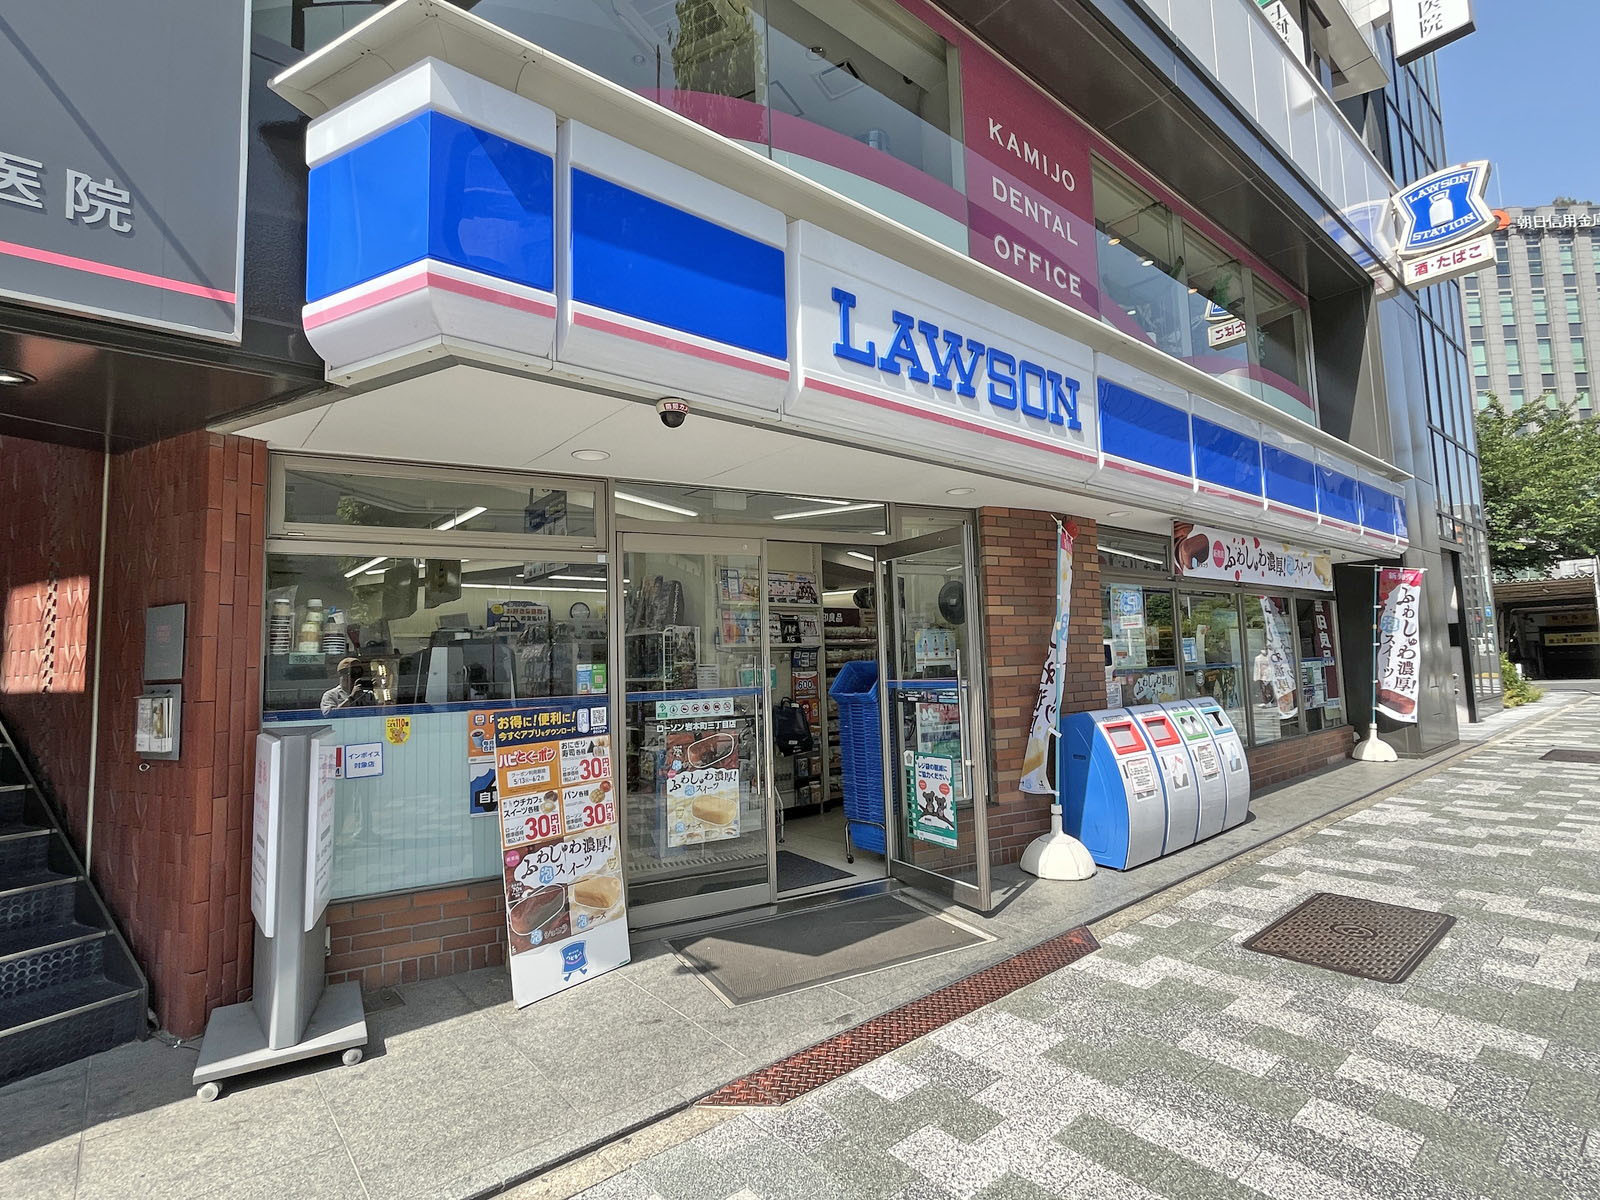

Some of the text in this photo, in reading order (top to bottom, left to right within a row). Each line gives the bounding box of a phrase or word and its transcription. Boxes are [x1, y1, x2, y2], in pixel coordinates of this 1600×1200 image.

[988, 117, 1075, 192] KAMIJO
[0, 152, 133, 234] 医院
[1407, 173, 1471, 204] LAWSON
[992, 176, 1079, 246] DENTAL
[1412, 212, 1476, 241] STATION
[994, 234, 1082, 298] OFFICE
[831, 287, 1082, 432] LAWSON
[497, 711, 576, 730] お得に!便利に!
[498, 726, 576, 742] 今すぐアプリをダウンロード
[348, 751, 381, 760] インボイス
[580, 758, 602, 780] 30
[525, 814, 551, 840] 30
[583, 803, 606, 827] 30
[521, 835, 612, 879] ふわしゅわ濃厚!
